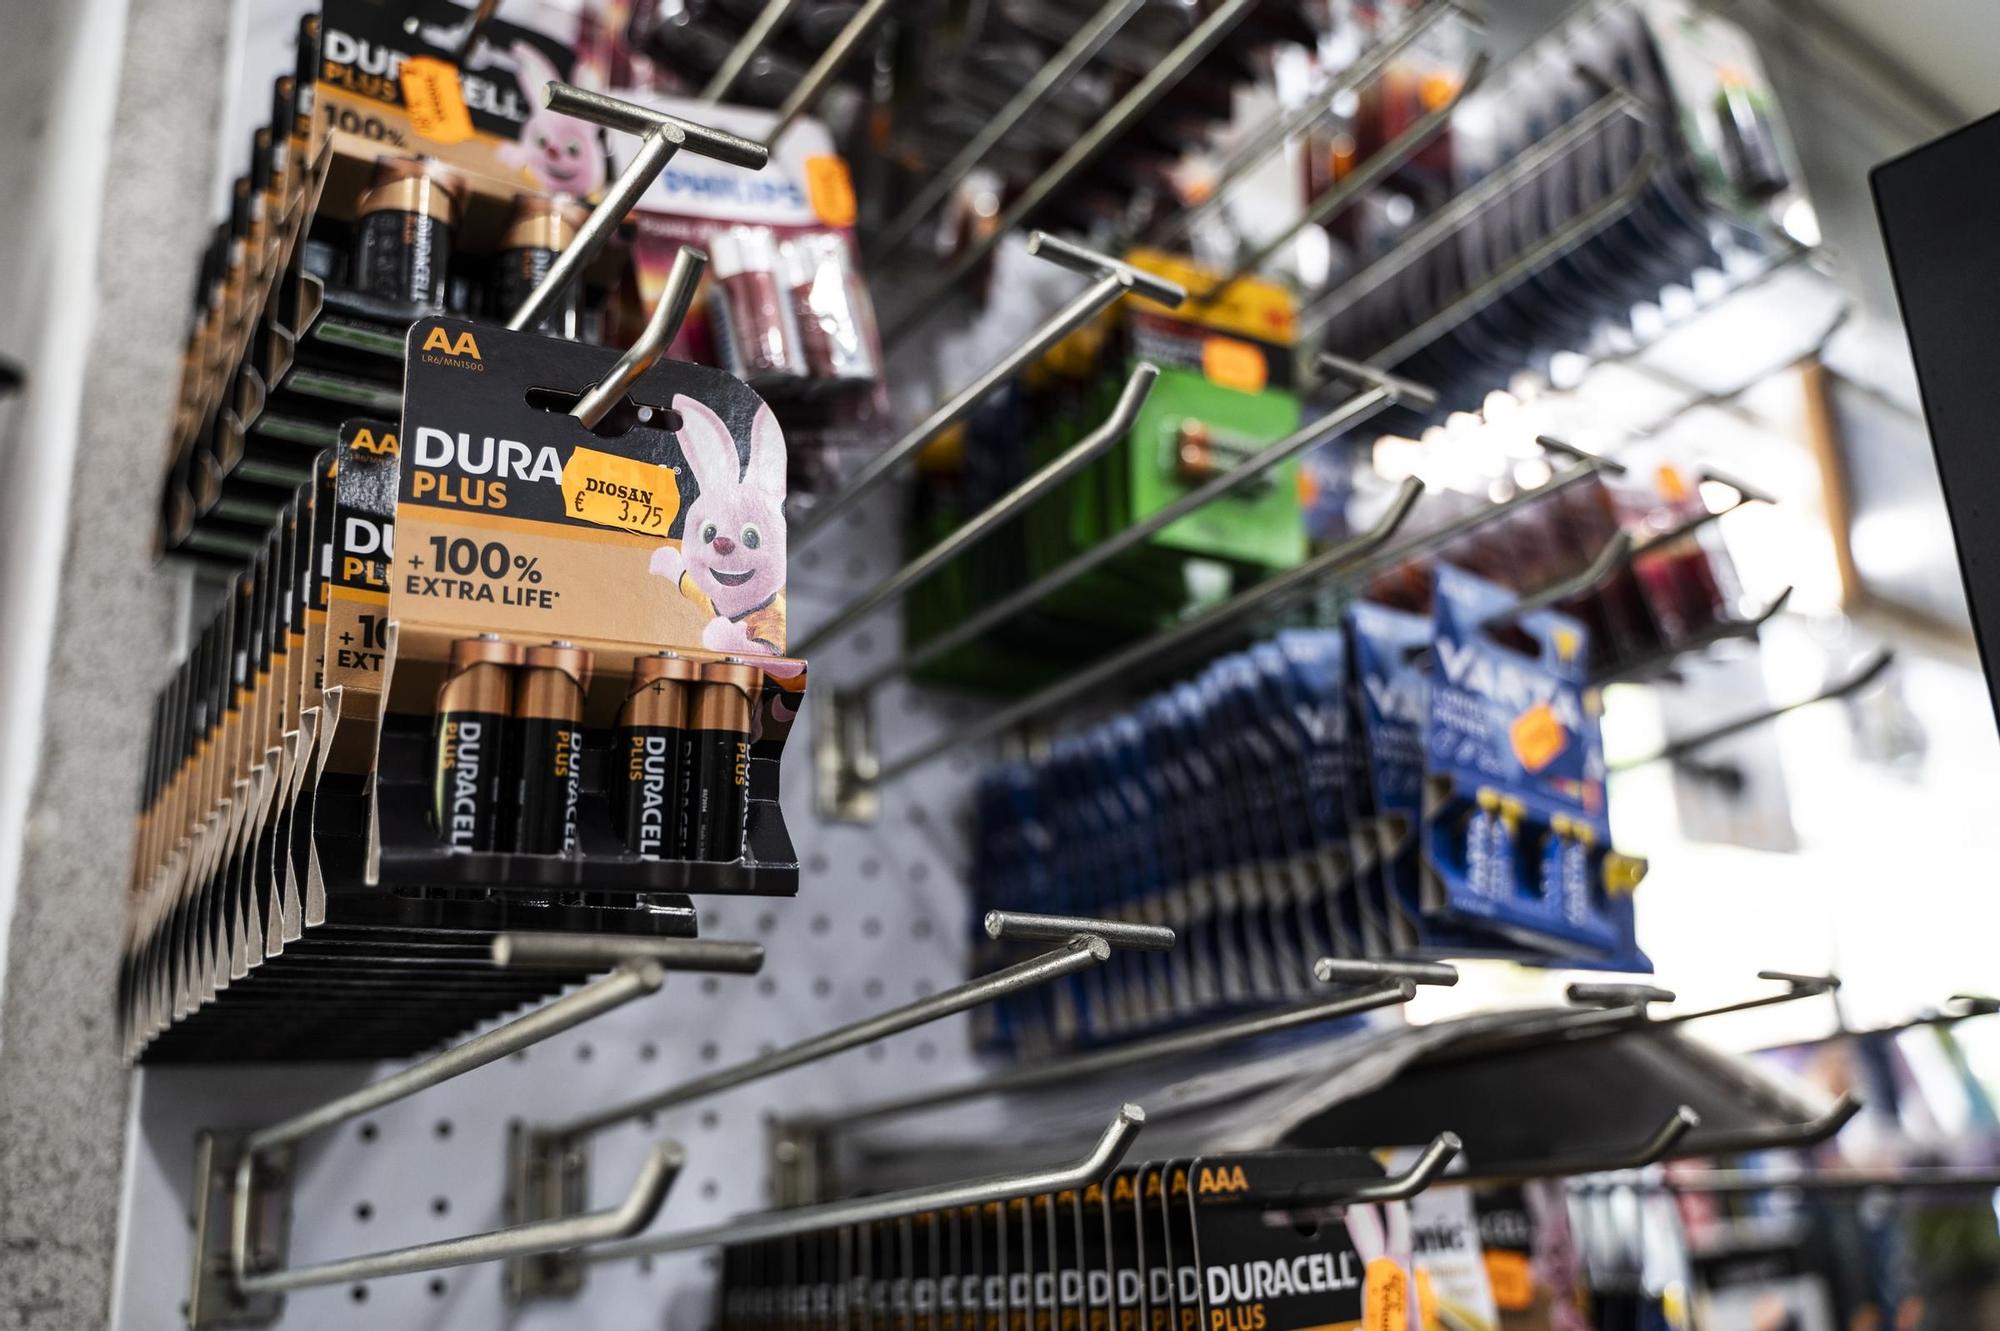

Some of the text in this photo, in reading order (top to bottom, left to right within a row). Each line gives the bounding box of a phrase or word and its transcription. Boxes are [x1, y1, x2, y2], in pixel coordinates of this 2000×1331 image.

[324, 29, 525, 123] DUELL
[422, 326, 481, 360] AA
[421, 354, 484, 372] LR6/MN1500
[351, 428, 400, 457] AA
[413, 427, 562, 485] DURA
[412, 470, 508, 509] PLUS
[585, 477, 653, 505] DIOSAN
[574, 490, 663, 528] € 3,75
[344, 556, 392, 586] PL
[406, 574, 495, 603] EXTRA
[338, 649, 384, 671] EXT
[442, 721, 458, 769] PLUS
[554, 730, 571, 777] PLUS
[629, 736, 645, 781] PLUS
[735, 742, 747, 786] PLUS
[564, 731, 581, 850] DURACEL
[1199, 1166, 1249, 1193] AAA
[1207, 1250, 1357, 1304] DURACELL
[1211, 1303, 1266, 1331] PLUS
